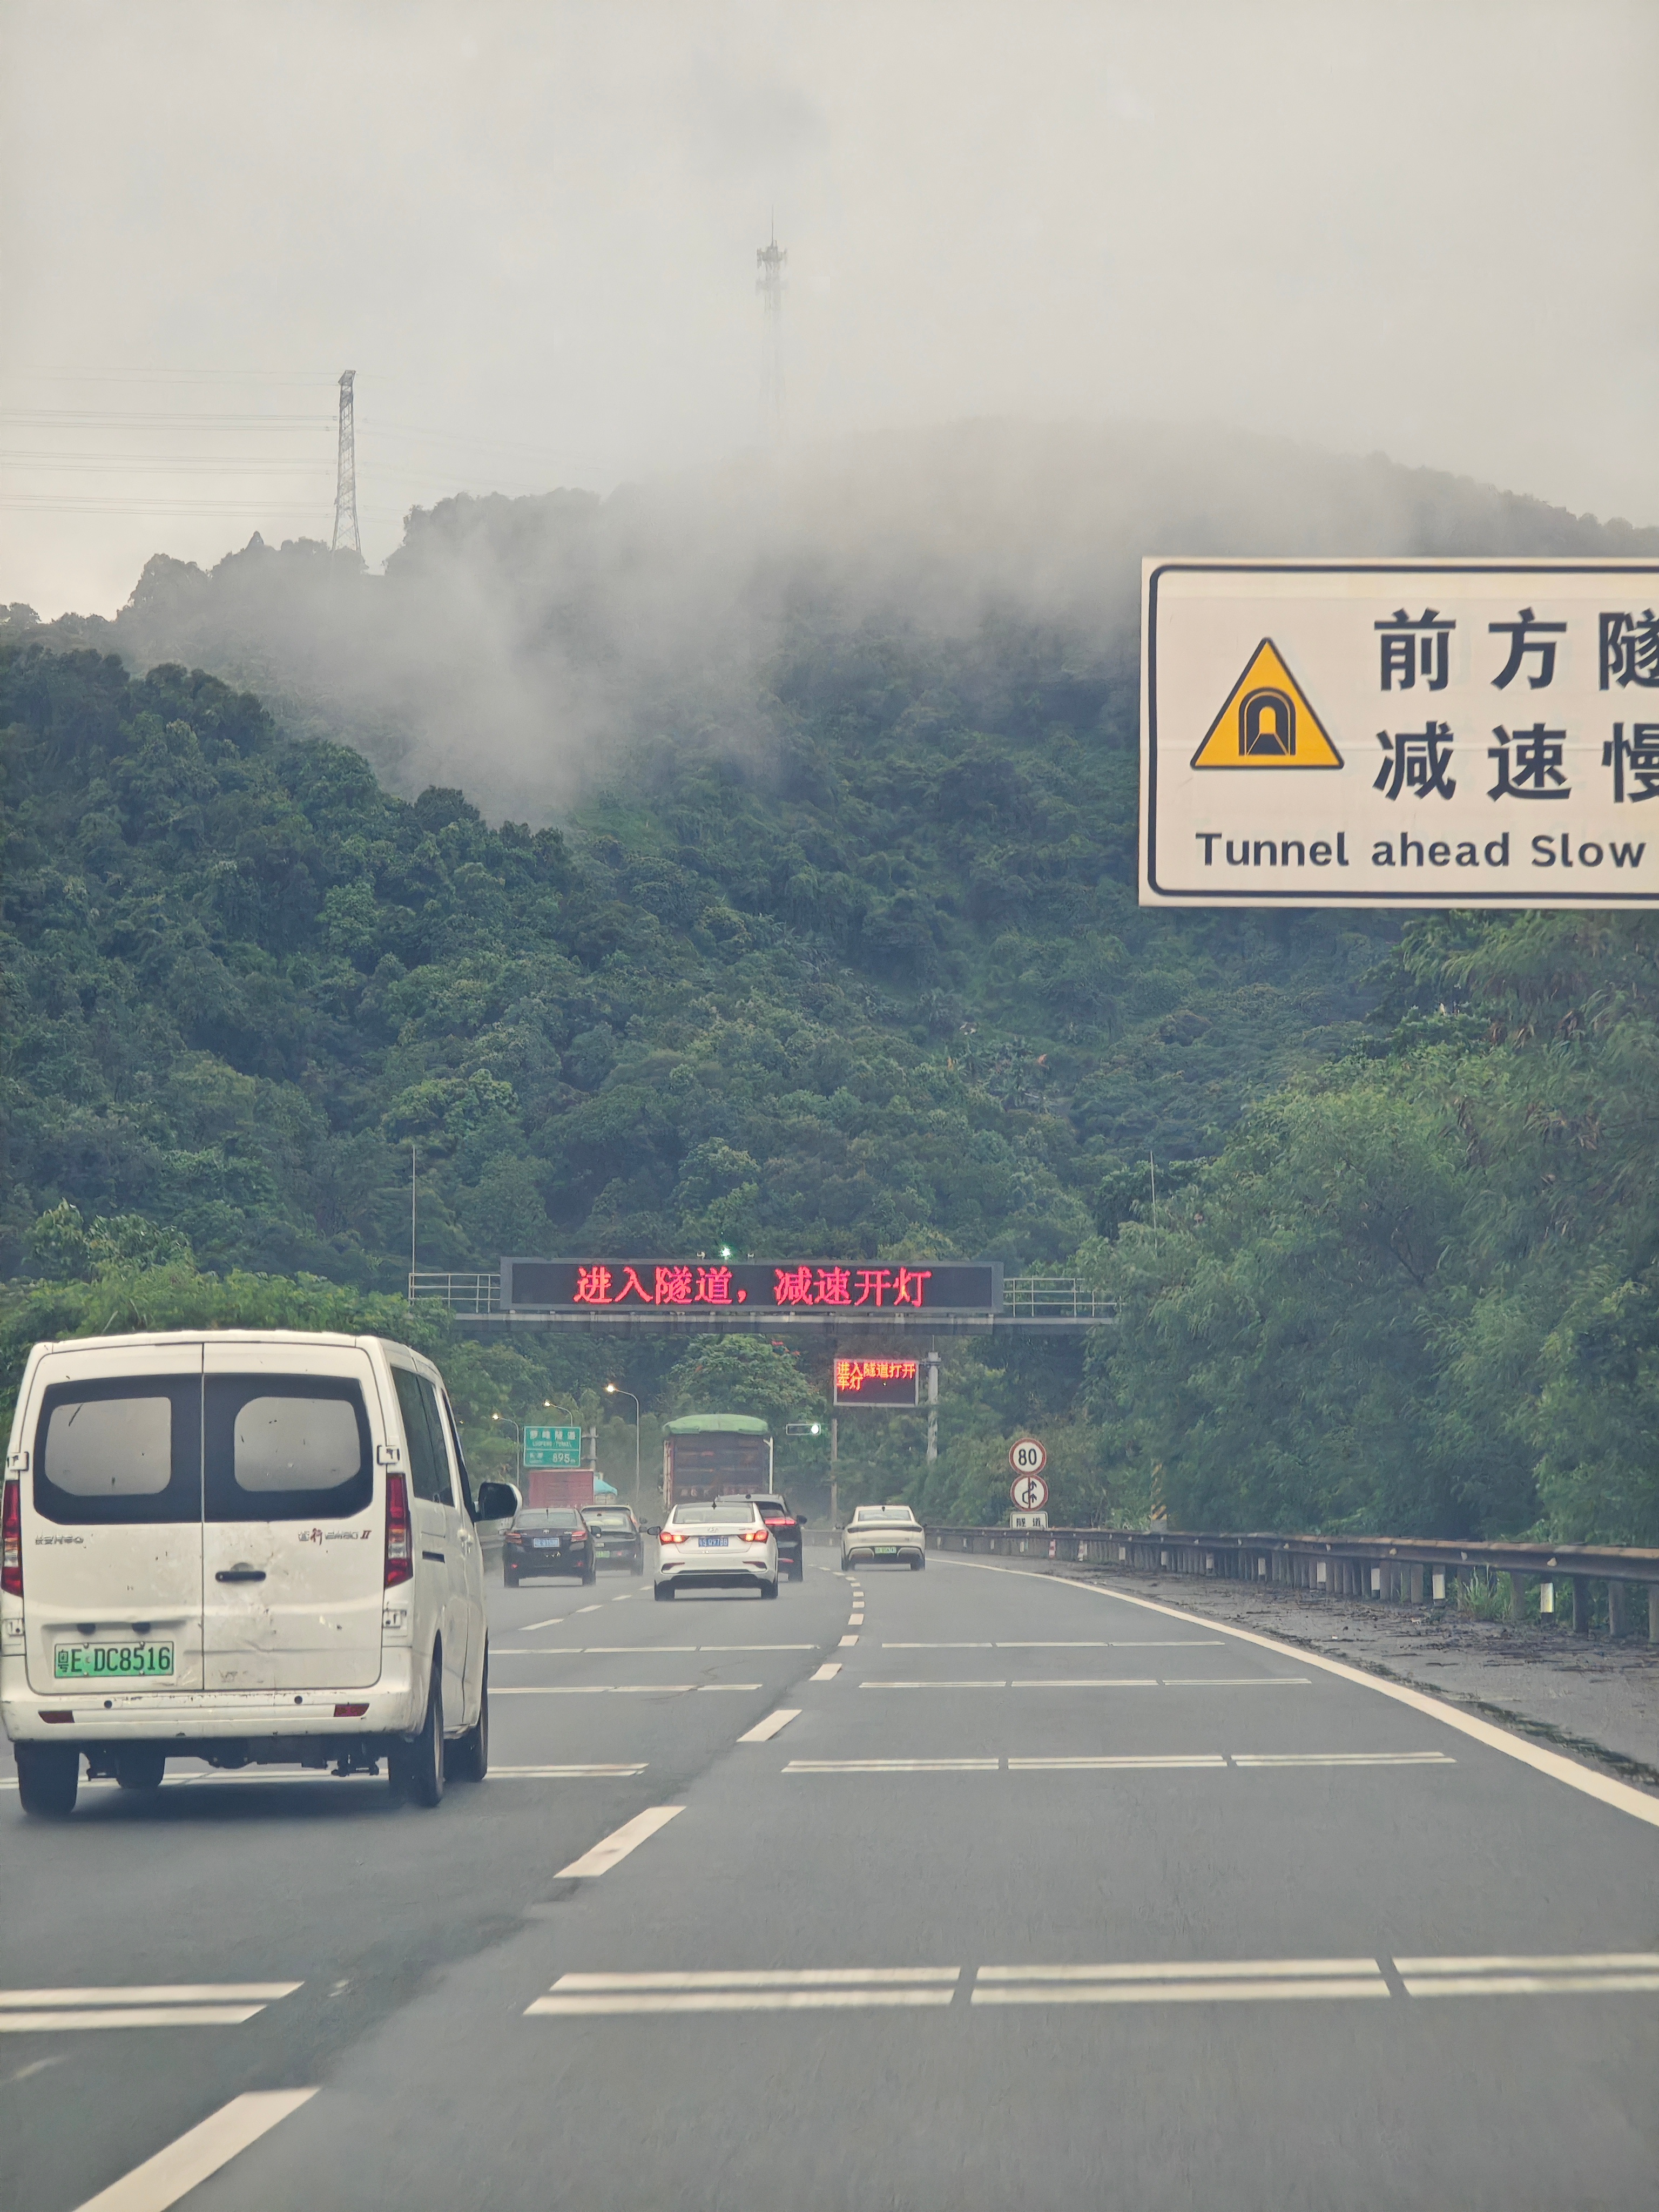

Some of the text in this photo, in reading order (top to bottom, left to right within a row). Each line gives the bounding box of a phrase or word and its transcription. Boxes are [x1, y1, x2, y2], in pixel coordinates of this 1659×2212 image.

[1374, 607, 1659, 691] 前方隧
[1372, 720, 1659, 803] 减速慢
[1195, 832, 1647, 868] Tunnel ahead Slow
[837, 1361, 916, 1379] 进入隧道打开
[837, 1375, 864, 1391] 车灯
[1018, 1448, 1037, 1466] 80
